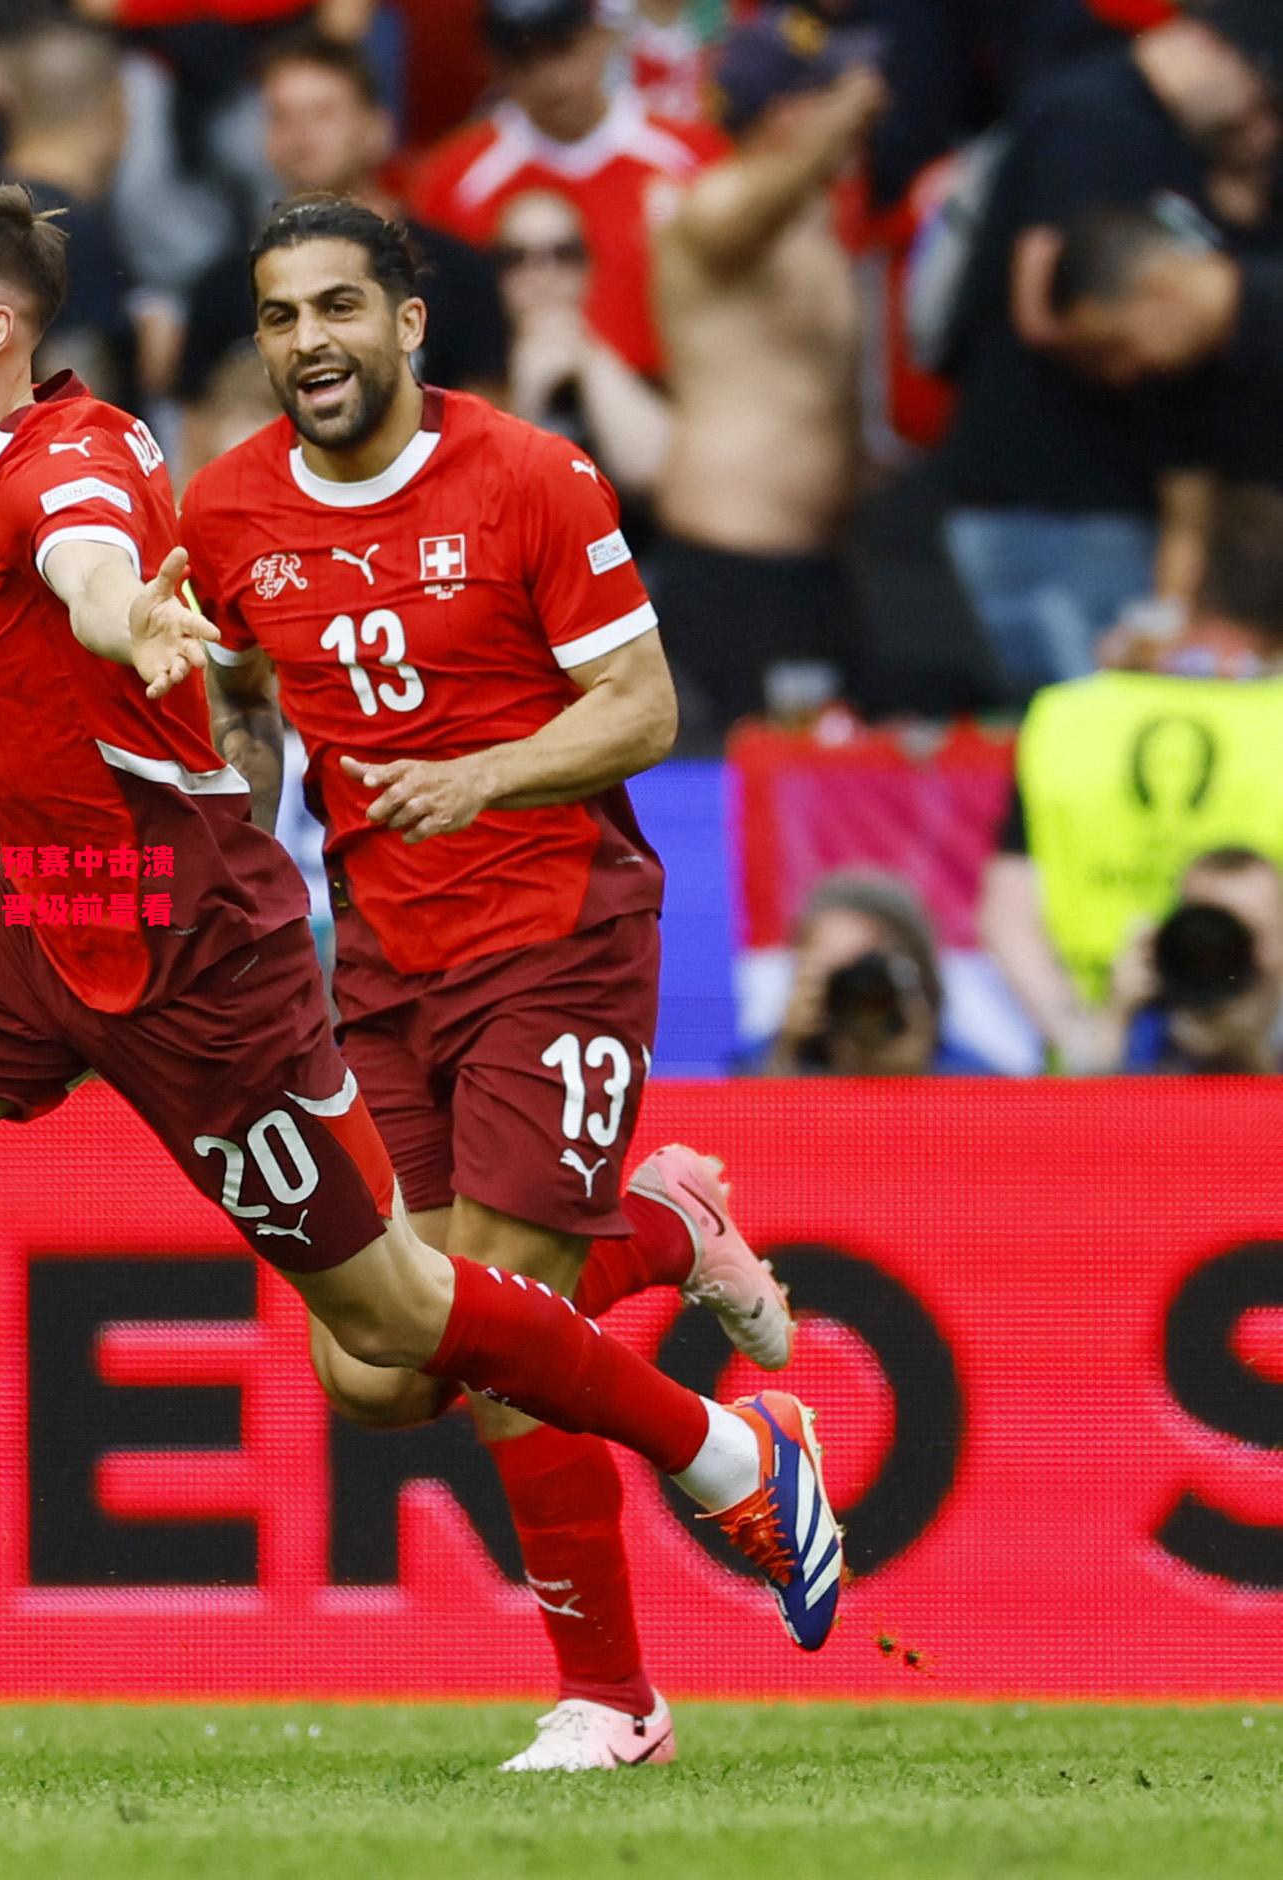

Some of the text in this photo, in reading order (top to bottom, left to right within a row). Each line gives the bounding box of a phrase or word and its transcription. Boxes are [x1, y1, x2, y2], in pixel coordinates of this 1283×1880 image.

[321, 609, 425, 716] 13
[541, 1033, 631, 1147] 13
[193, 1109, 319, 1218] 20
